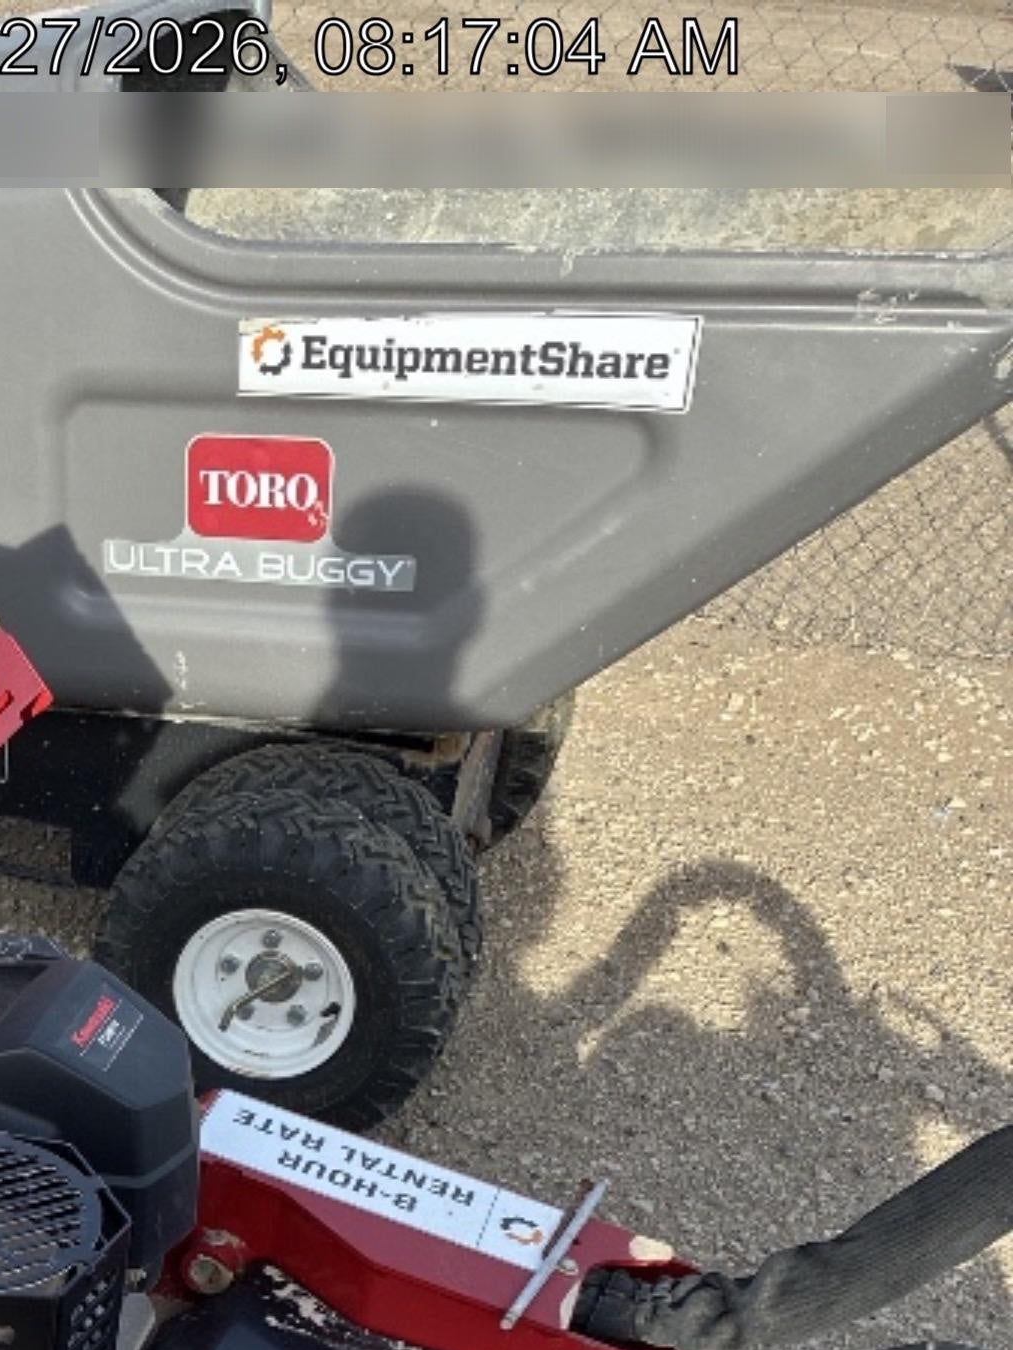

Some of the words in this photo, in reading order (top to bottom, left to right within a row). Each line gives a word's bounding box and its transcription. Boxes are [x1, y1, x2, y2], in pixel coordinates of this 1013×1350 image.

[301, 336, 671, 382] EquipmentShare
[200, 469, 318, 511] TORO
[109, 542, 242, 578] ULTRA
[258, 550, 404, 587] BUGGY
[232, 1107, 326, 1154] RATE
[340, 1145, 475, 1207] RENTAL
